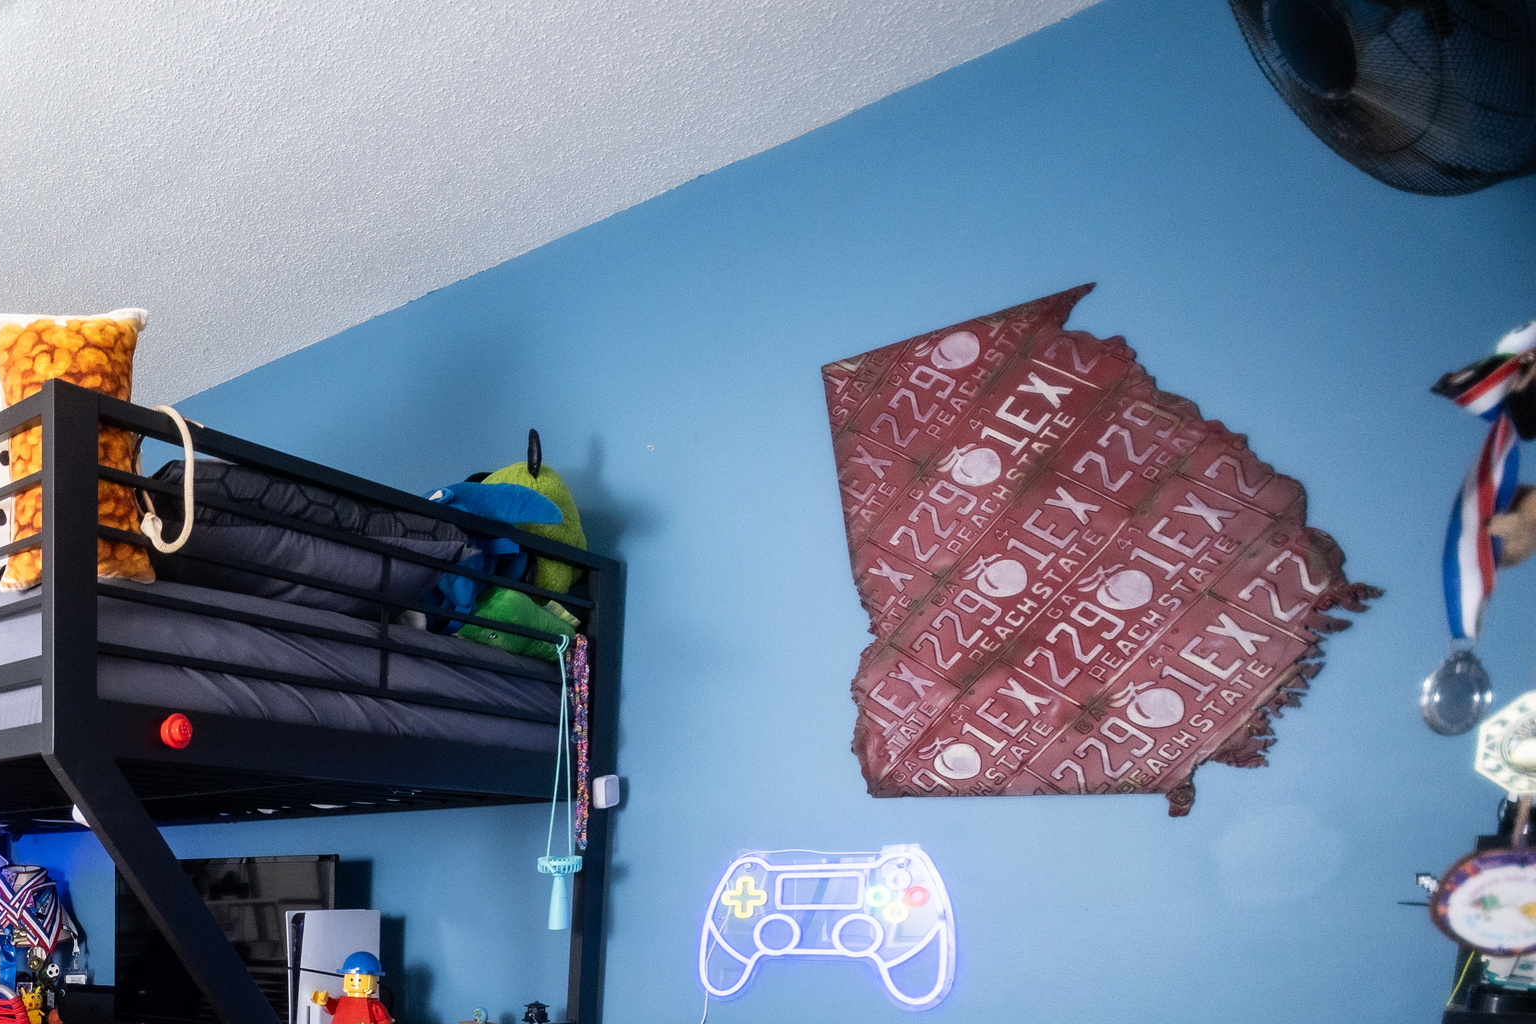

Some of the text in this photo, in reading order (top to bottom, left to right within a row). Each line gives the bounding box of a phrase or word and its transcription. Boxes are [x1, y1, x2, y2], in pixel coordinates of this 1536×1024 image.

[869, 365, 957, 449] 229
[889, 371, 1074, 563] 229 1EX
[925, 367, 988, 439] PEACH
[946, 411, 1076, 555] PEACH STATE
[911, 486, 1102, 671] 229 1EX
[968, 528, 1106, 666] PEACH STATE
[1023, 491, 1239, 688] 229 1EX
[1088, 535, 1241, 683] PEACH STATE
[961, 677, 1053, 757] 1EX
[1160, 612, 1271, 702] 1EX
[983, 720, 1055, 785] STATE
[1119, 660, 1273, 793] PEACH STATE
